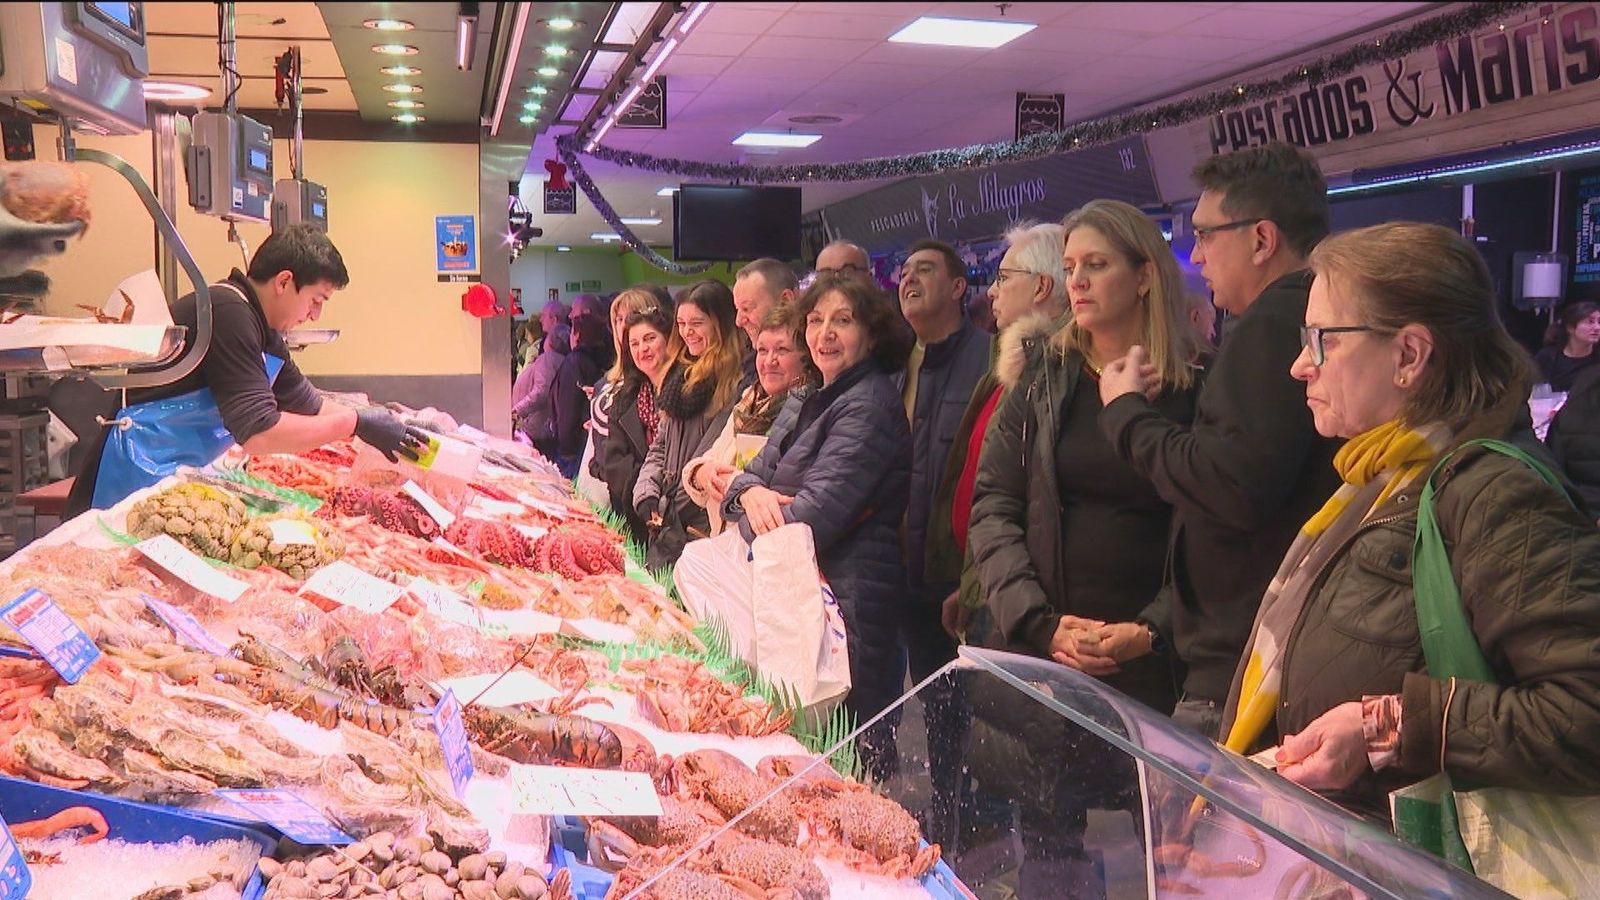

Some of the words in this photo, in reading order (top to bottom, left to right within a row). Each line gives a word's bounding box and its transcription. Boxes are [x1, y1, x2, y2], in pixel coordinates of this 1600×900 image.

[1383, 57, 1434, 127] &
[1118, 148, 1137, 171] 132
[870, 209, 921, 234] PESCADERIA
[947, 183, 966, 228] La
[971, 172, 1046, 222] Milagros
